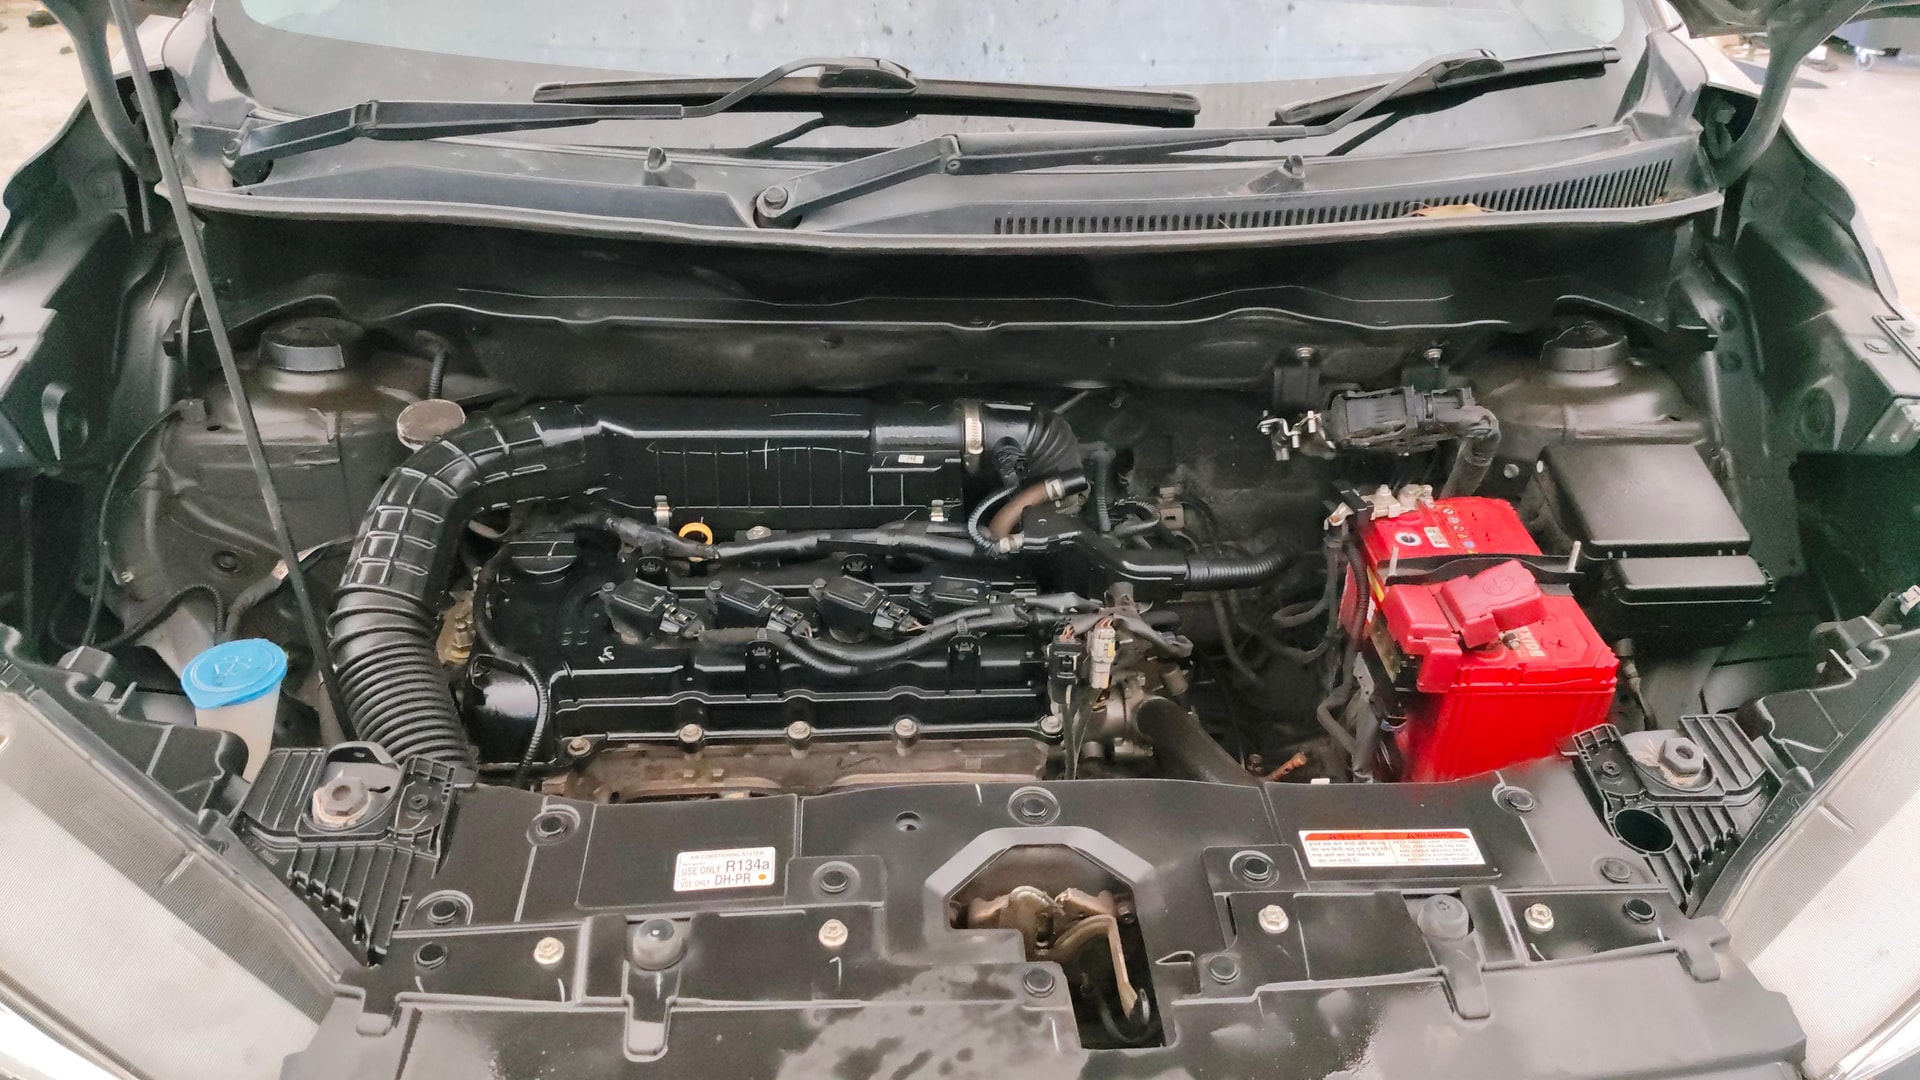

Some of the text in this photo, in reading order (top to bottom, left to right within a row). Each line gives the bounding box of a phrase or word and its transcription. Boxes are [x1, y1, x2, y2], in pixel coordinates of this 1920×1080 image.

[681, 859, 770, 876] USE ONLY R134a
[714, 873, 751, 885] DH-PR
